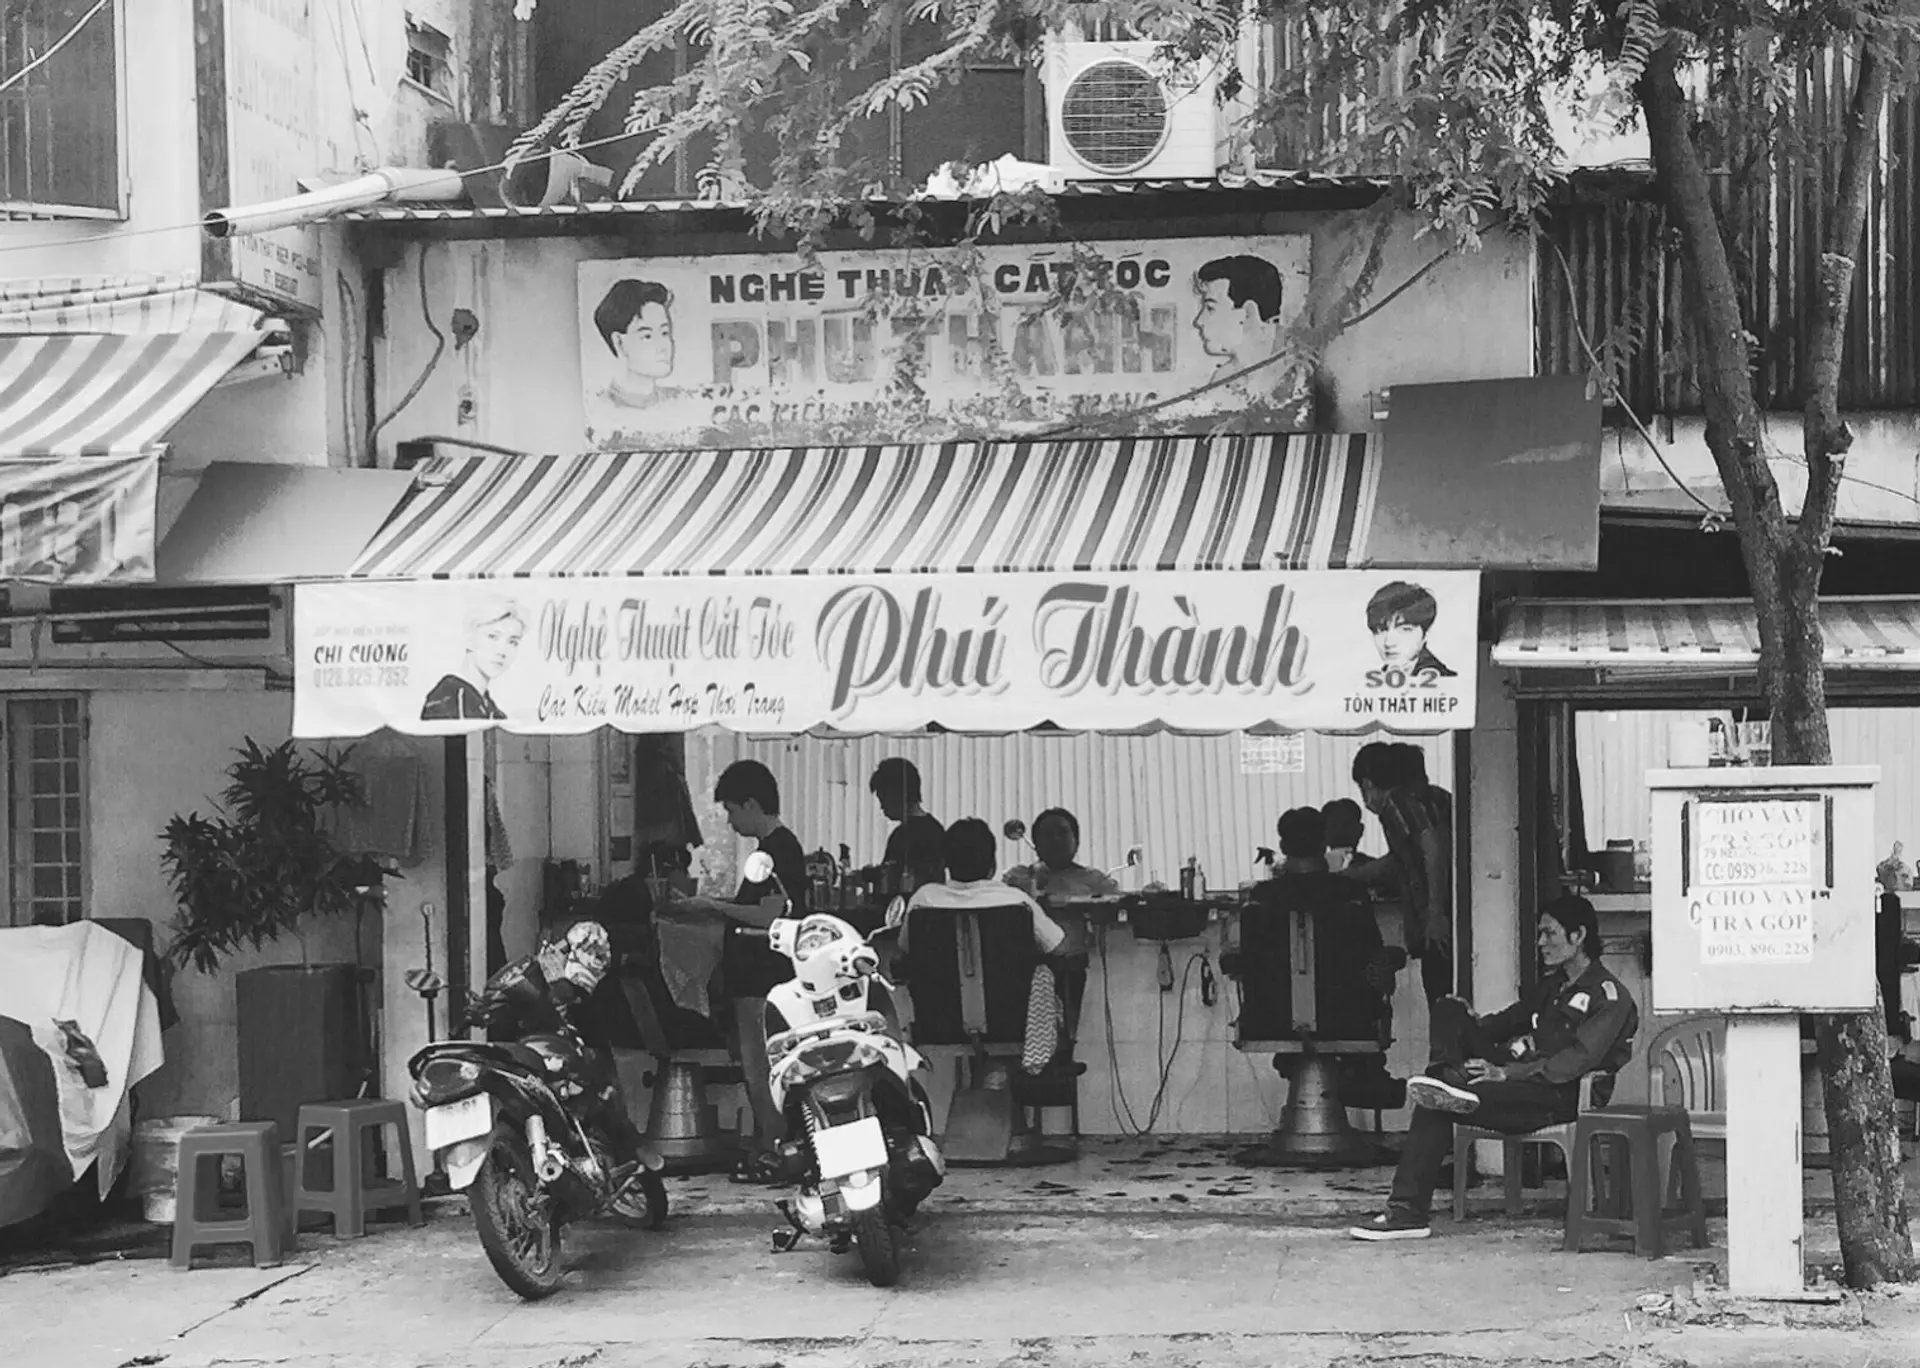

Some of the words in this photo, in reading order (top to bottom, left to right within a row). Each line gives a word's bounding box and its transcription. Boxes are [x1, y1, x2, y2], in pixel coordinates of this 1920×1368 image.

[539, 598, 607, 678] Nghệ
[616, 597, 692, 677] Thuật
[748, 596, 794, 661] Tóc
[815, 584, 1010, 721] Phú
[1032, 581, 1316, 698] Thành
[743, 681, 785, 724] Trang
[1706, 889, 1755, 906] CHO
[1762, 888, 1808, 905] VAY
